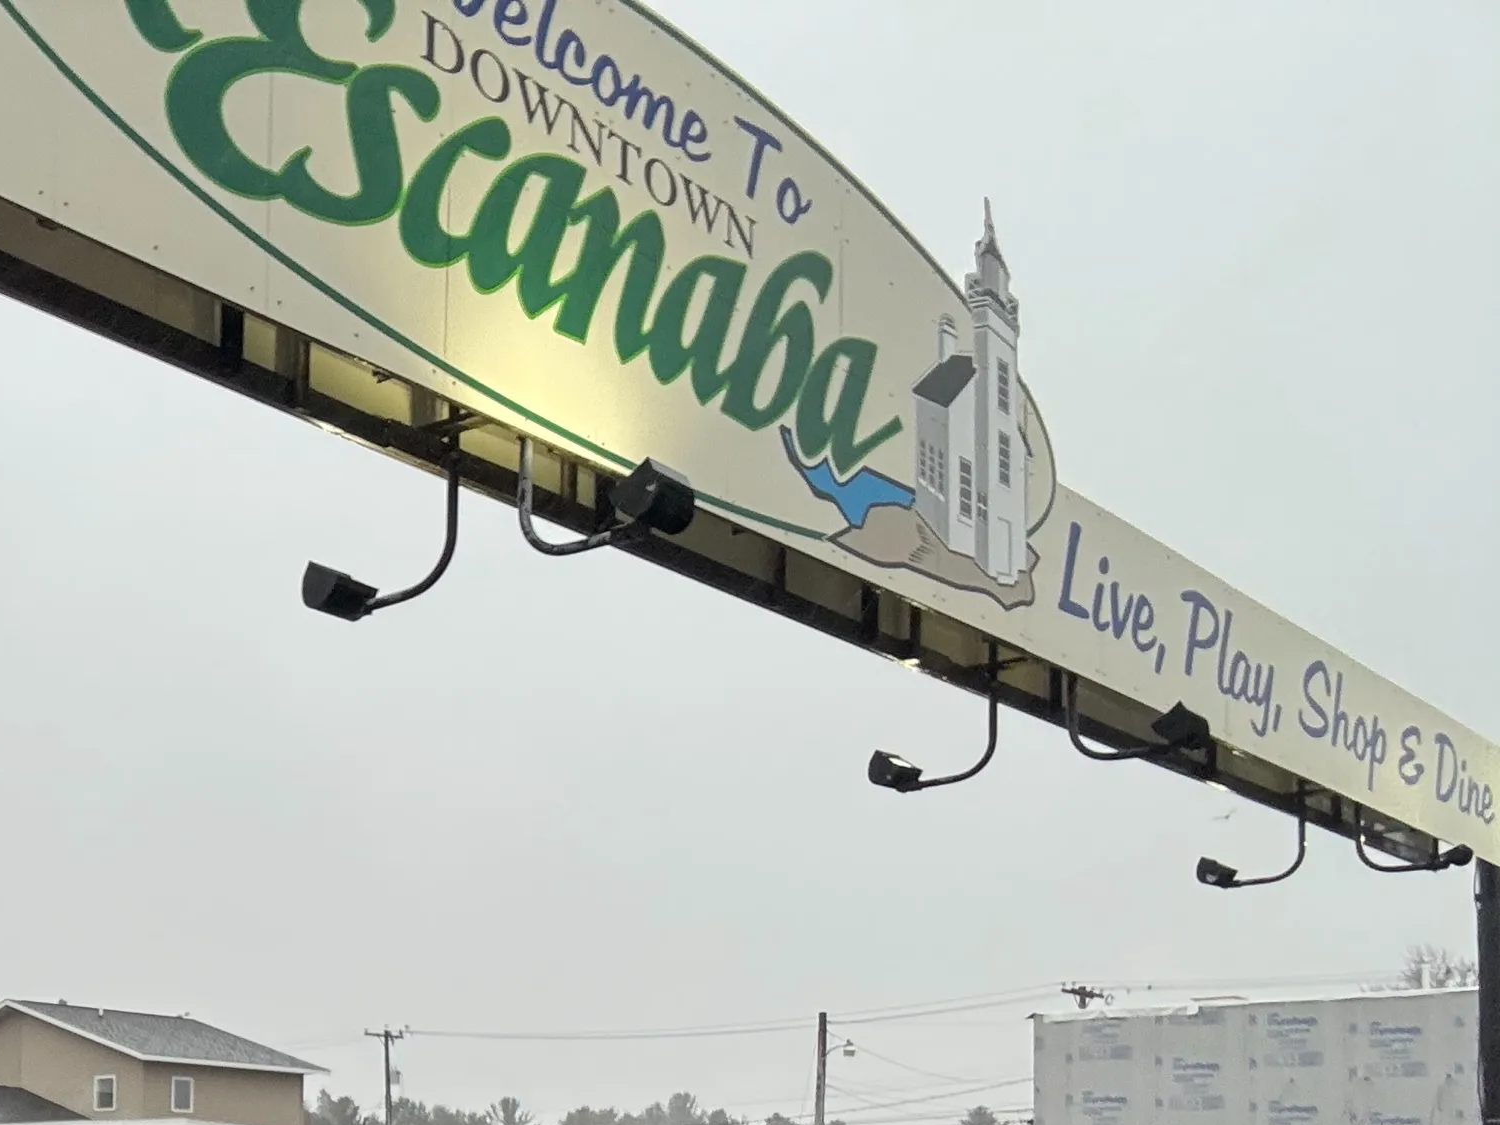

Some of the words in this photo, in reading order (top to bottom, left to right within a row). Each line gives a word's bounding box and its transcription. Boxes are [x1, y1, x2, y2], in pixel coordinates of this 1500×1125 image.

[420, 10, 759, 260] DOWNTOWN
[454, 0, 712, 162] elcome
[733, 115, 814, 225] To
[1057, 521, 1167, 675] Live,
[1180, 589, 1283, 738] Play,
[1298, 659, 1388, 791] Shop
[1399, 724, 1425, 786] &
[1434, 732, 1496, 825] Dine
